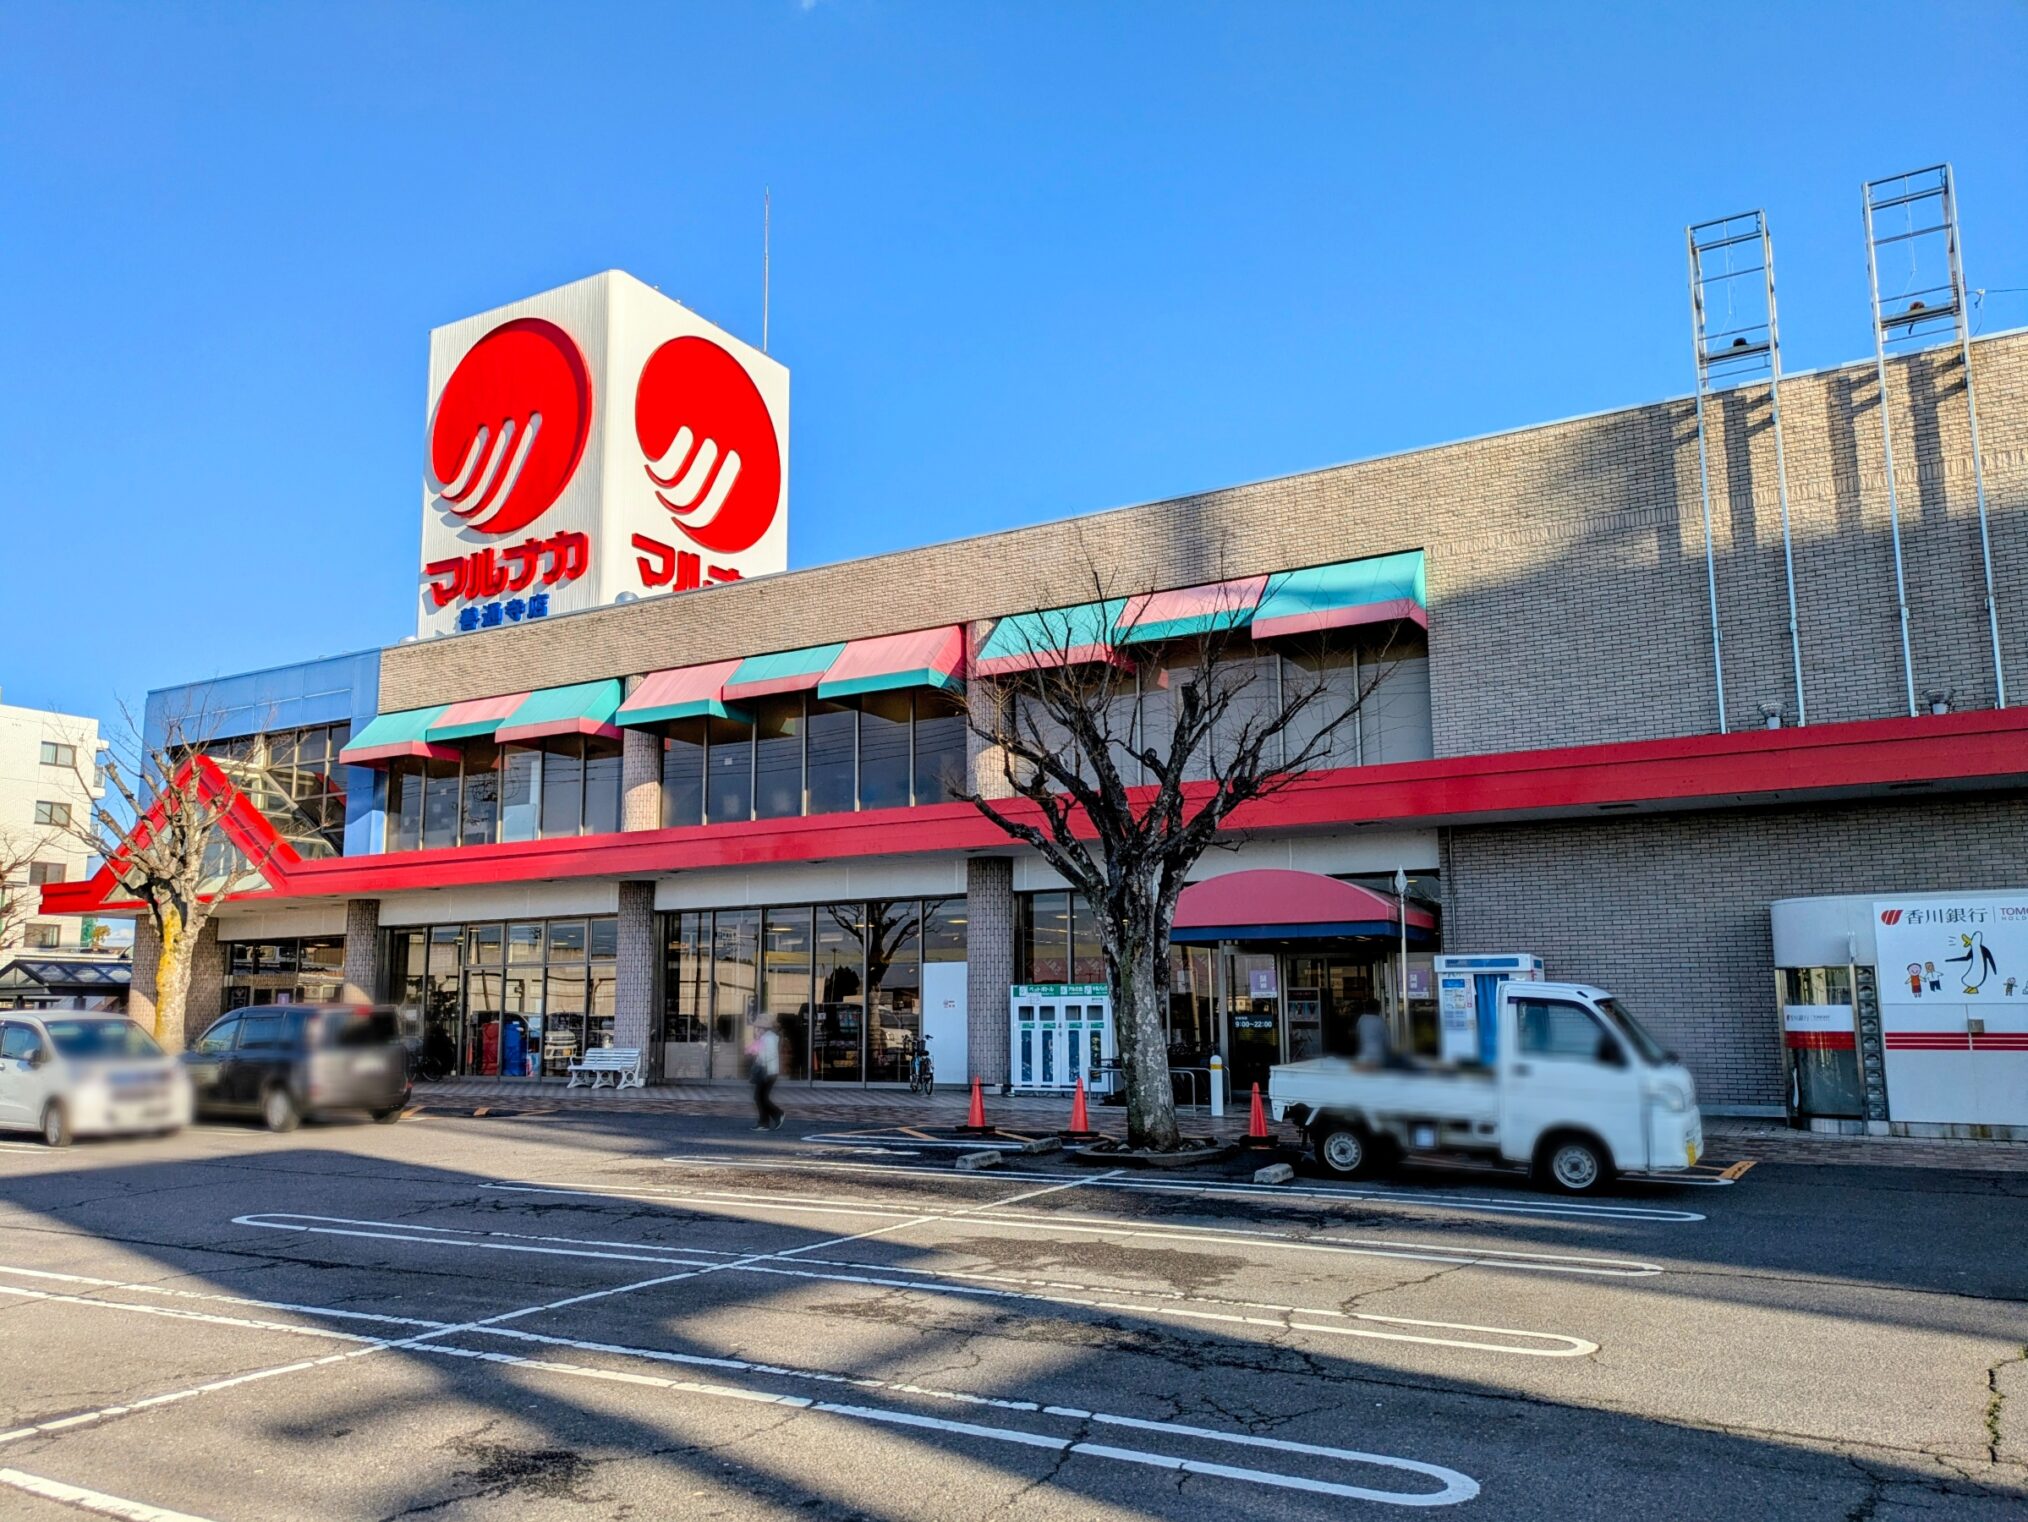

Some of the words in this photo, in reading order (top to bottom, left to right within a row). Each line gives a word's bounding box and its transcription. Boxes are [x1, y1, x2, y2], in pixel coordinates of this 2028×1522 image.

[426, 531, 588, 607] マルナカ
[459, 593, 550, 631] 善通寺店
[1905, 907, 1988, 925] 香川銀行
[2000, 907, 2028, 916] TOM
